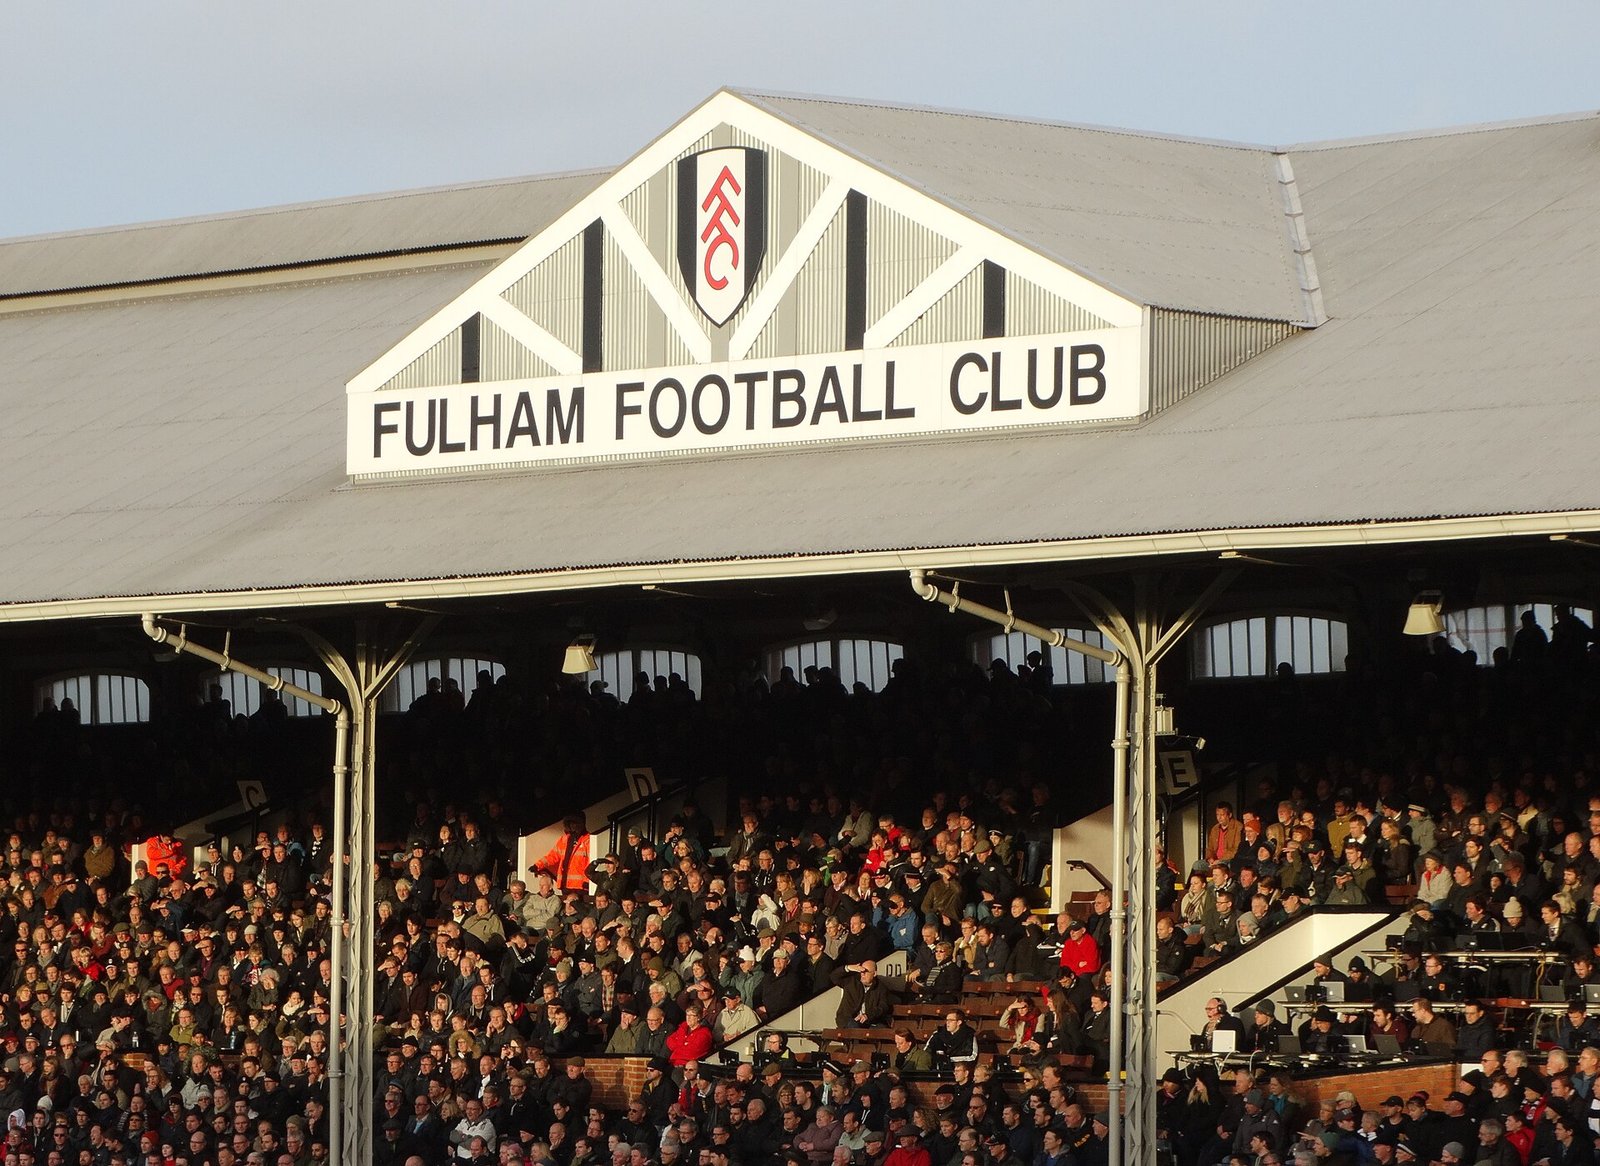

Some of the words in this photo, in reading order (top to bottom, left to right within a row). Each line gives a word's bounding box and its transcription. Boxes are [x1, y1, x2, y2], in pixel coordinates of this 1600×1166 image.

[374, 387, 585, 458] FULHAM
[615, 361, 916, 441] FOOTBALL
[950, 344, 1107, 415] CLUB
[631, 774, 653, 801] D
[1167, 757, 1190, 788] E
